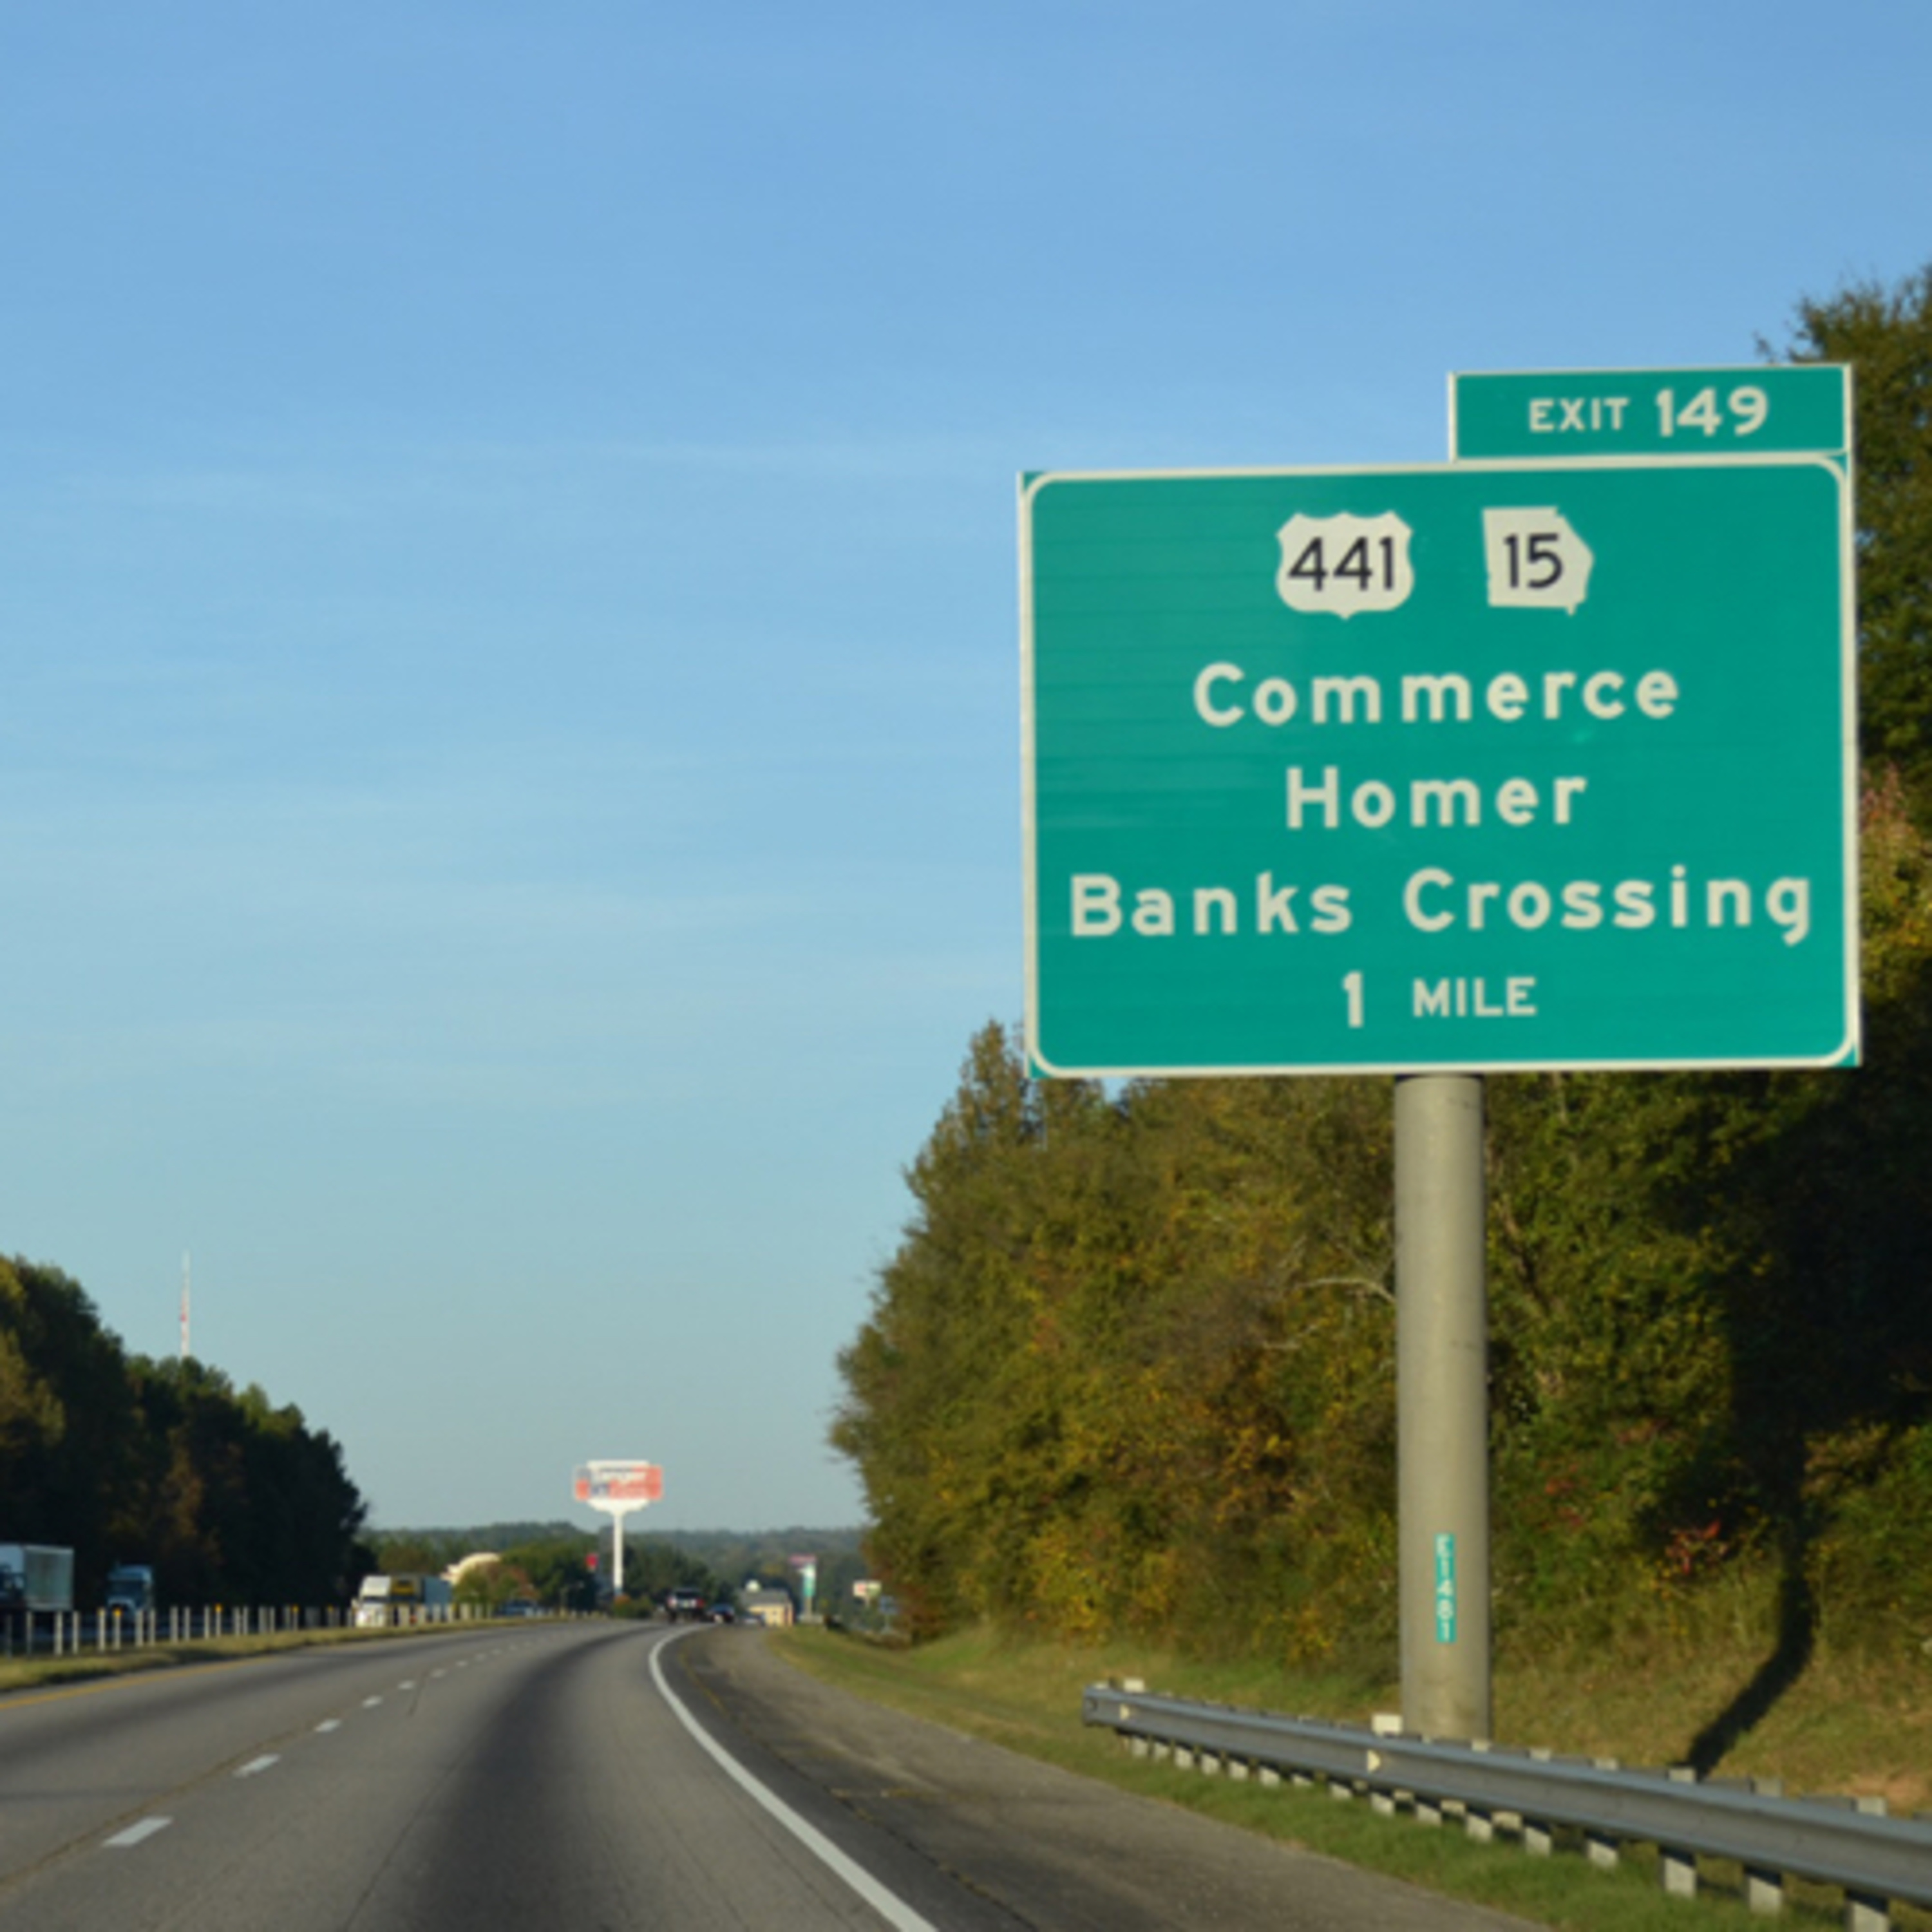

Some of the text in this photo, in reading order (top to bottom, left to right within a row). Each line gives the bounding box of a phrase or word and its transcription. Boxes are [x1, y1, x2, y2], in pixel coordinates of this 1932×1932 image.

[1530, 386, 1767, 435] EXIT 149
[1288, 536, 1395, 590] 441
[1506, 533, 1562, 588] 15
[1194, 663, 1678, 726] Commerce
[1287, 766, 1586, 828] Homer
[1072, 866, 1809, 945] Banks Crossing
[1344, 972, 1536, 1027] 1 MILE
